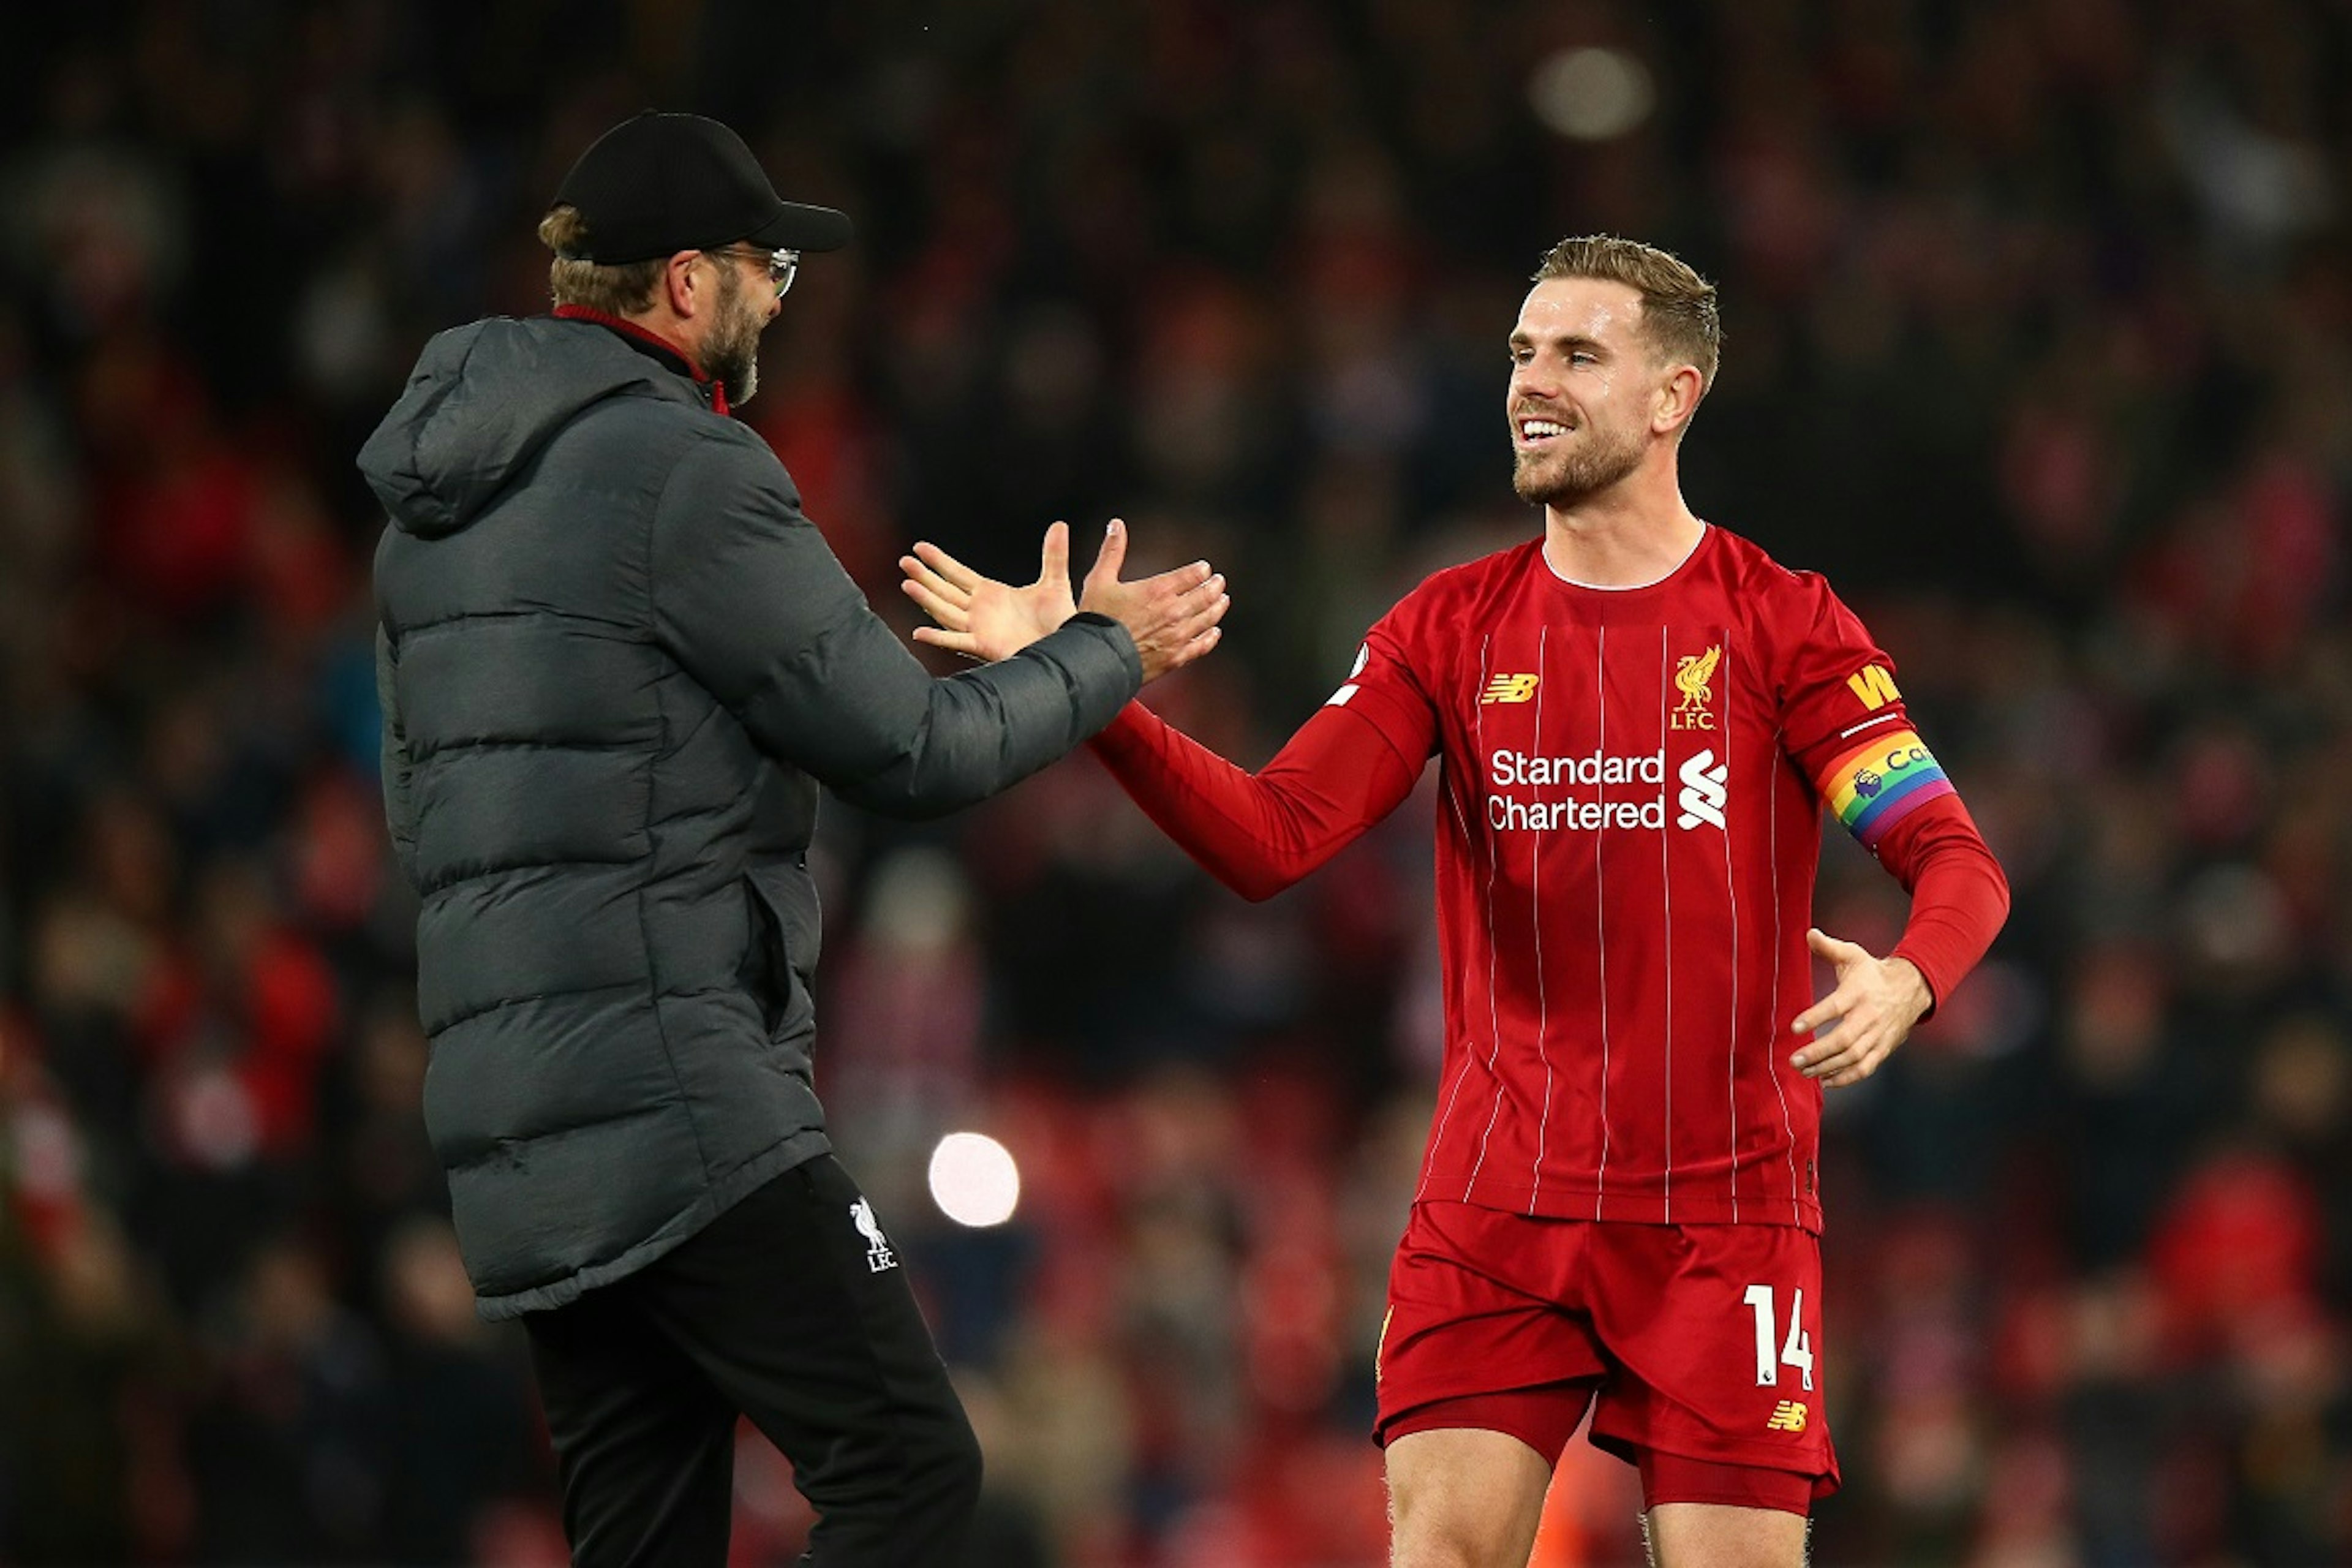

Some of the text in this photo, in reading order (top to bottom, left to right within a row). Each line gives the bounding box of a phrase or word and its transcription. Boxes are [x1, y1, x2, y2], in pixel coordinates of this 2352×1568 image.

[1491, 748, 1665, 785] Standard
[1887, 748, 1931, 771] Ca
[1488, 794, 1666, 831] Chartered
[1744, 1285, 1815, 1391] 14
